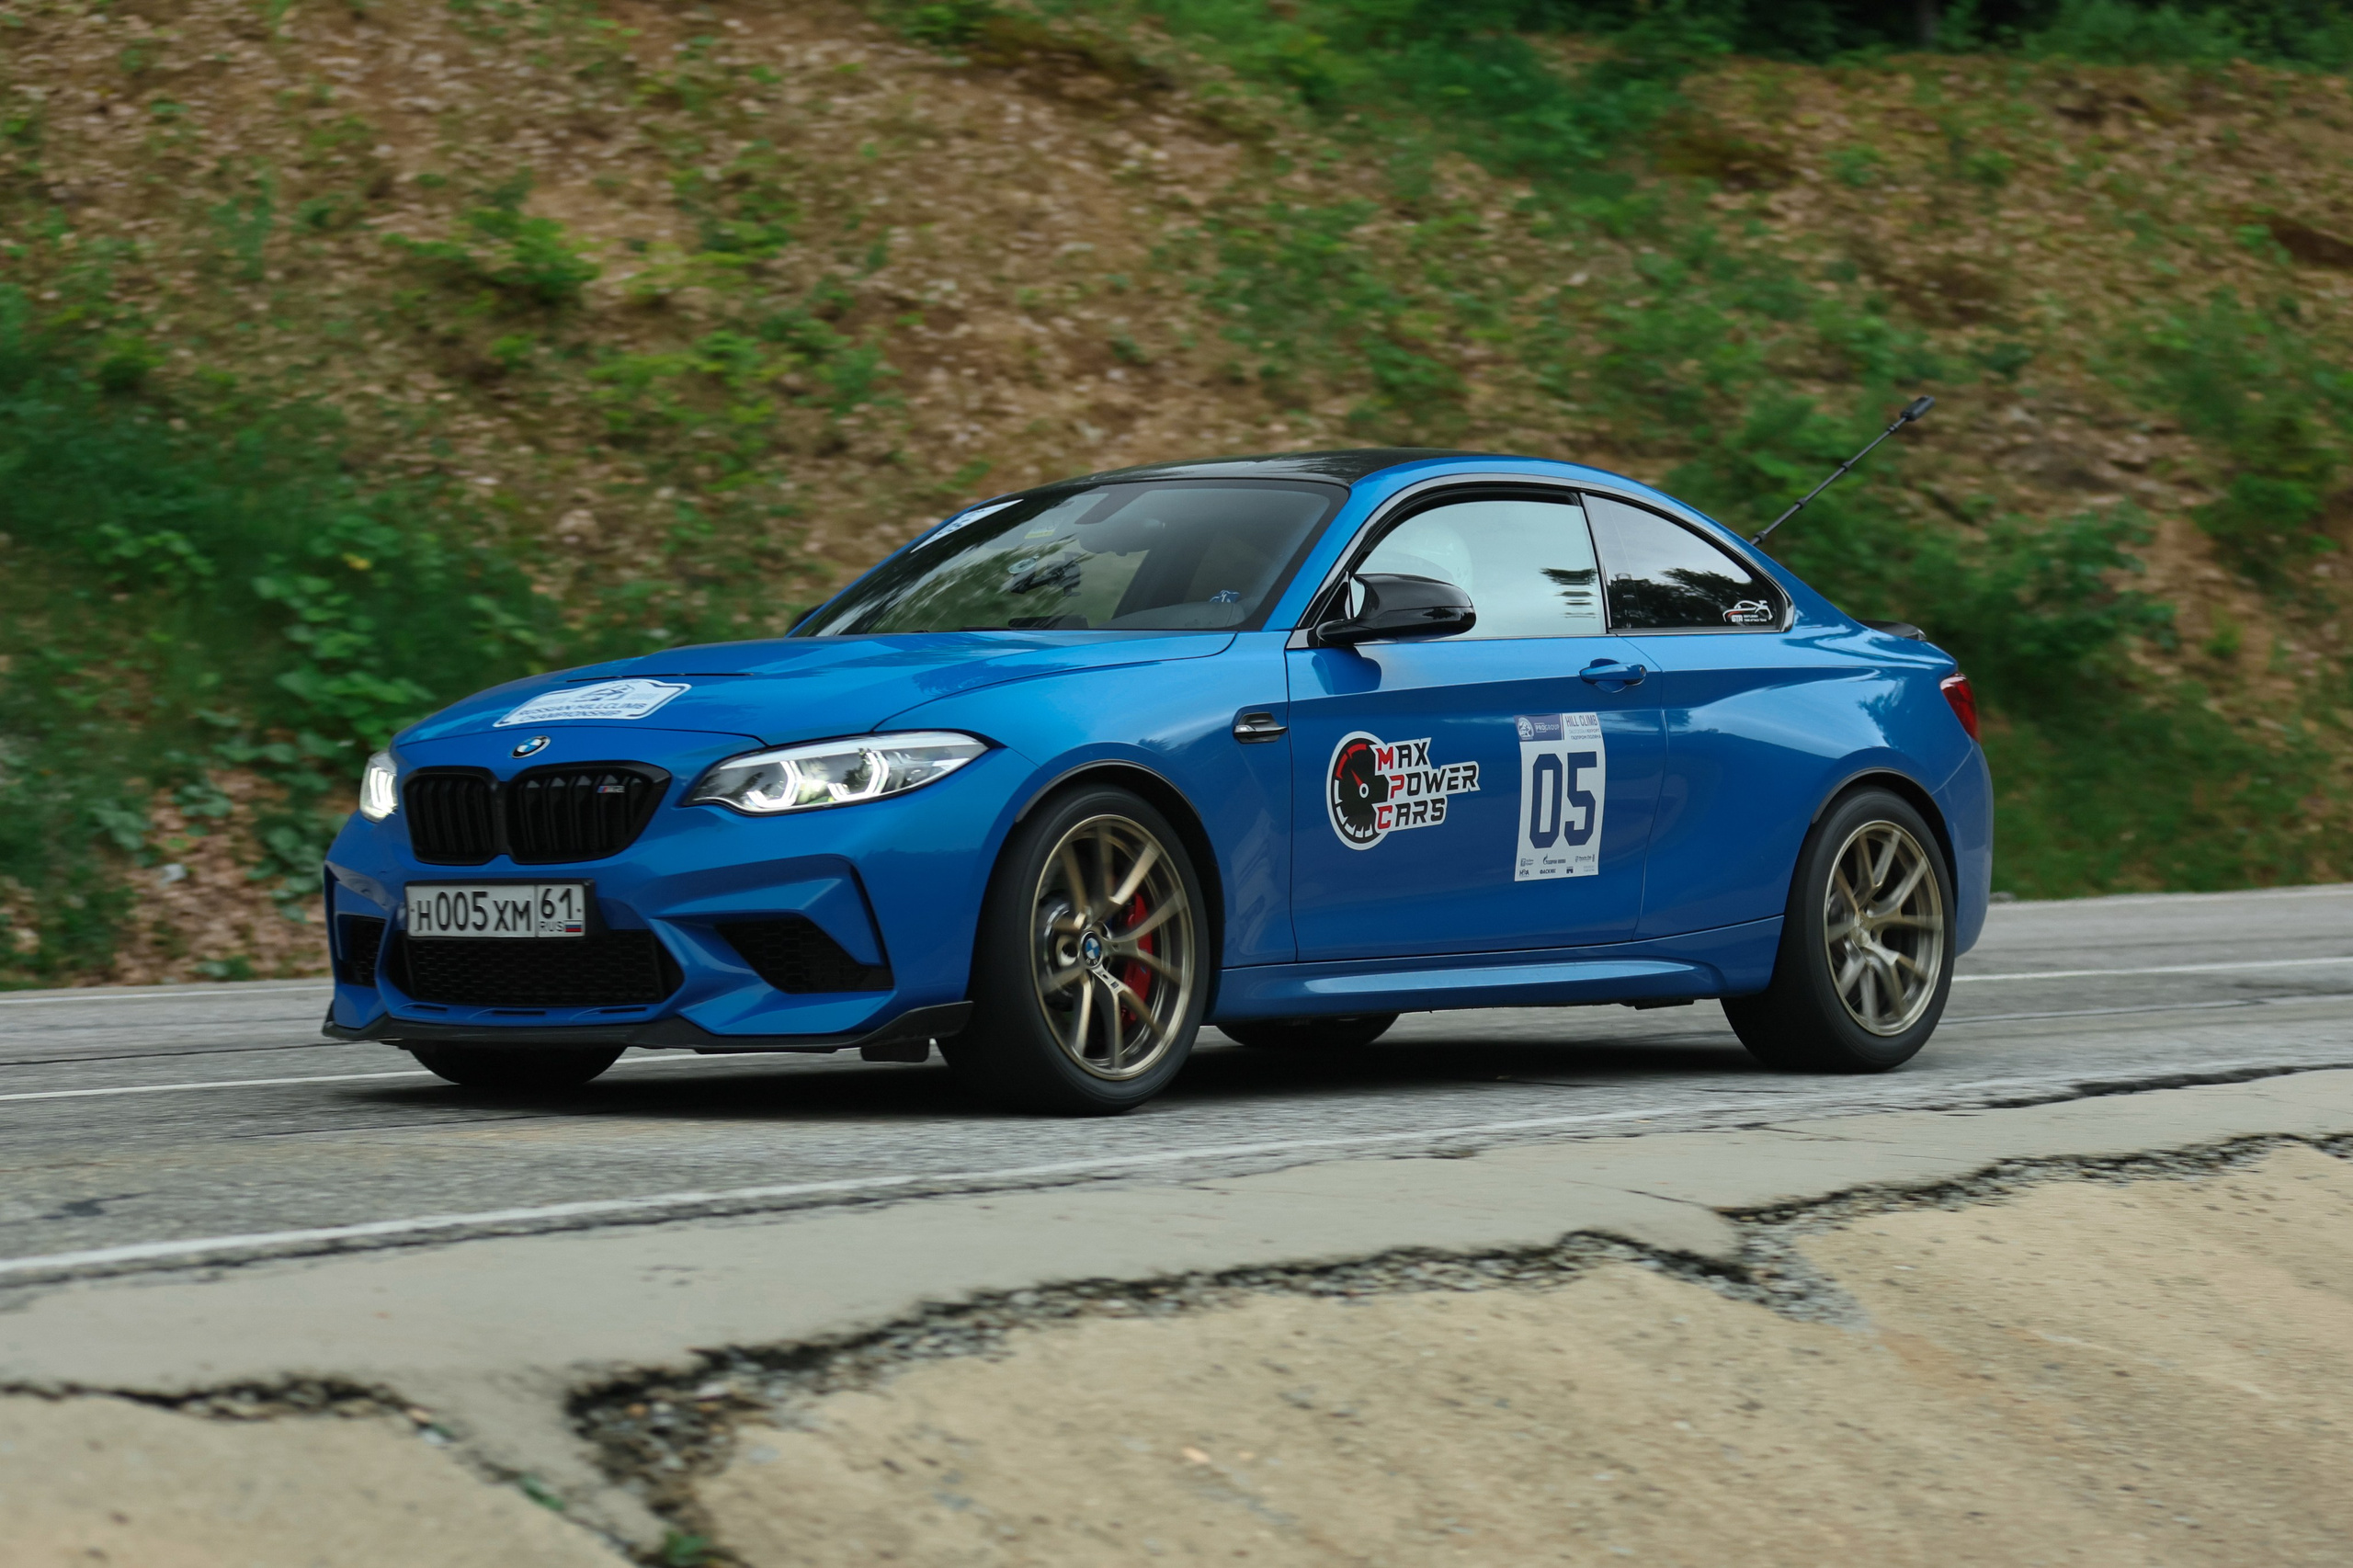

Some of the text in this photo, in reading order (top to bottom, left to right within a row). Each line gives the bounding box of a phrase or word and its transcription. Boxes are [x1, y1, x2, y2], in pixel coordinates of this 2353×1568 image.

[1565, 714, 1597, 727] HILL CLIMB
[1377, 741, 1427, 771] MAX
[1390, 764, 1477, 799] POWER
[1376, 797, 1445, 829] CARS
[1529, 751, 1597, 849] 05
[540, 888, 573, 919] 61
[540, 921, 564, 932] RUS
